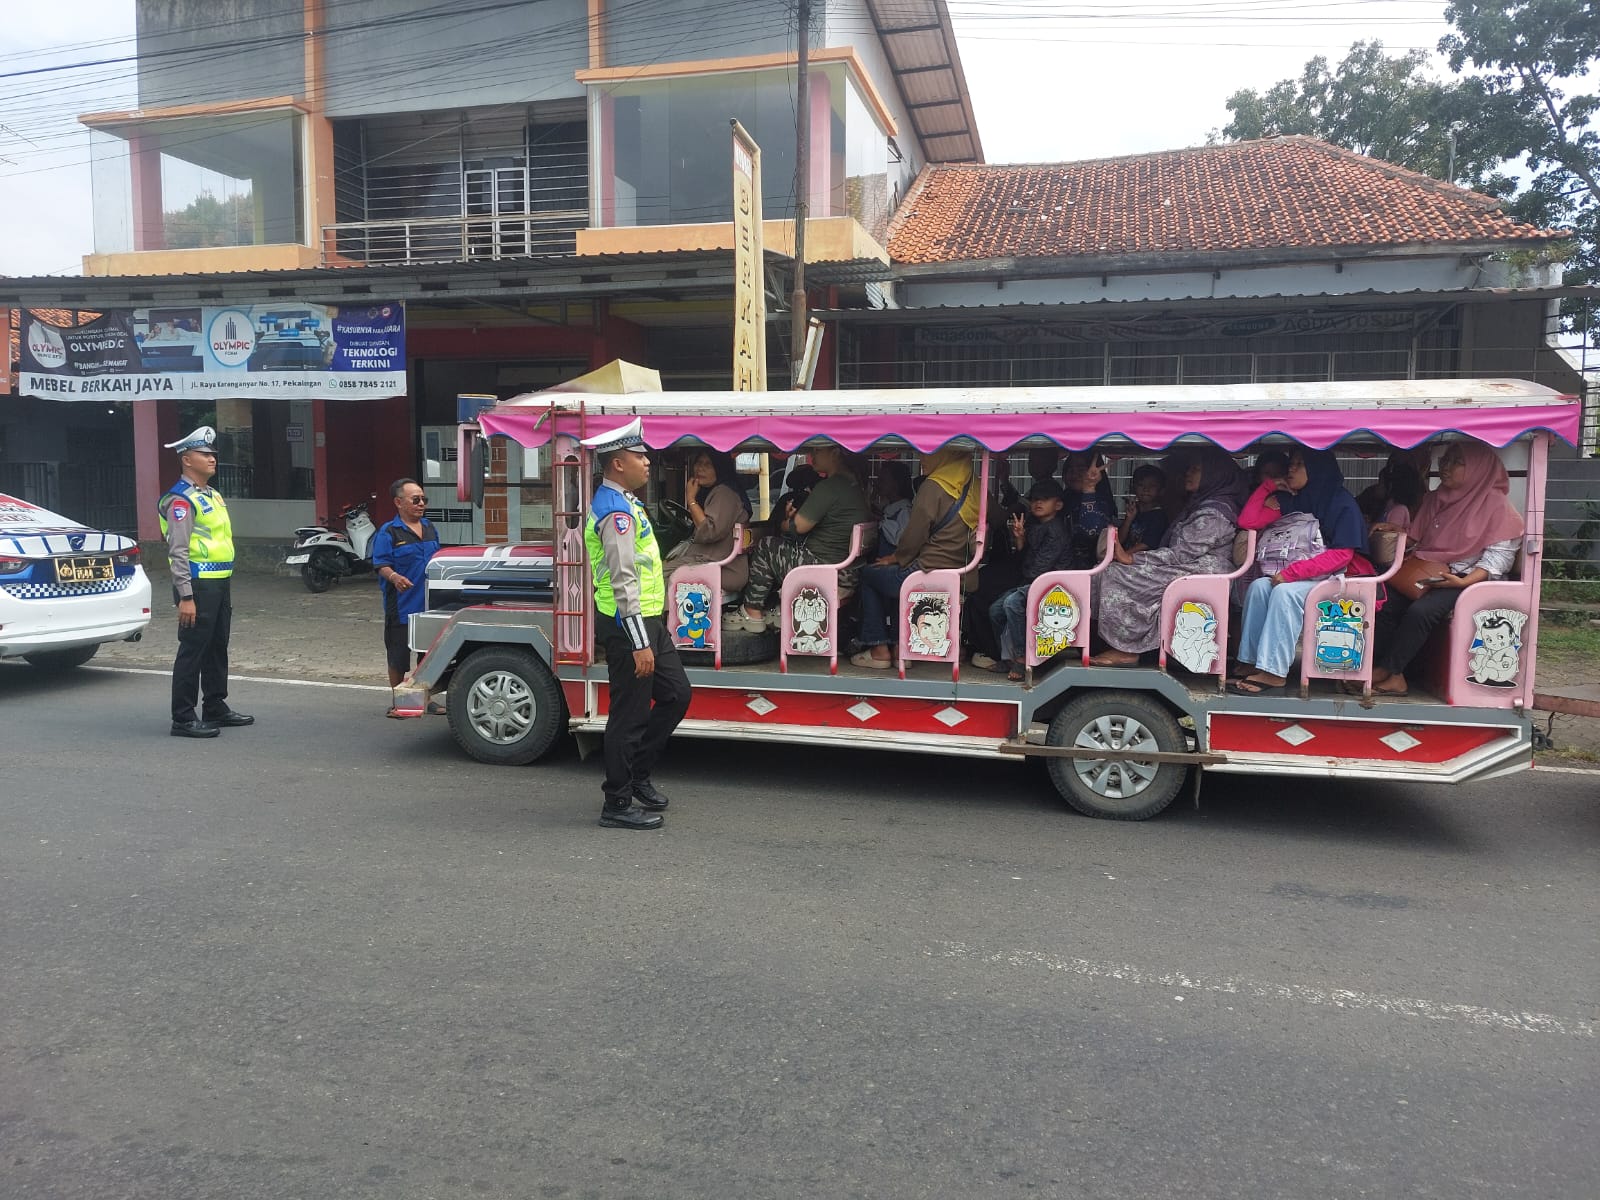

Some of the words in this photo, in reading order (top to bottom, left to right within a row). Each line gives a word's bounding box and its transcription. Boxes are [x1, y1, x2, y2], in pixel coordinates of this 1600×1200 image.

[213, 340, 251, 351] OLYMPIC
[342, 347, 398, 357] TEKNOLOGI
[351, 359, 391, 369] TERKINI
[30, 377, 76, 393] MEBEL
[81, 377, 131, 393] BERKAH
[135, 378, 173, 394] JAYA
[1317, 599, 1366, 617] TAYO
